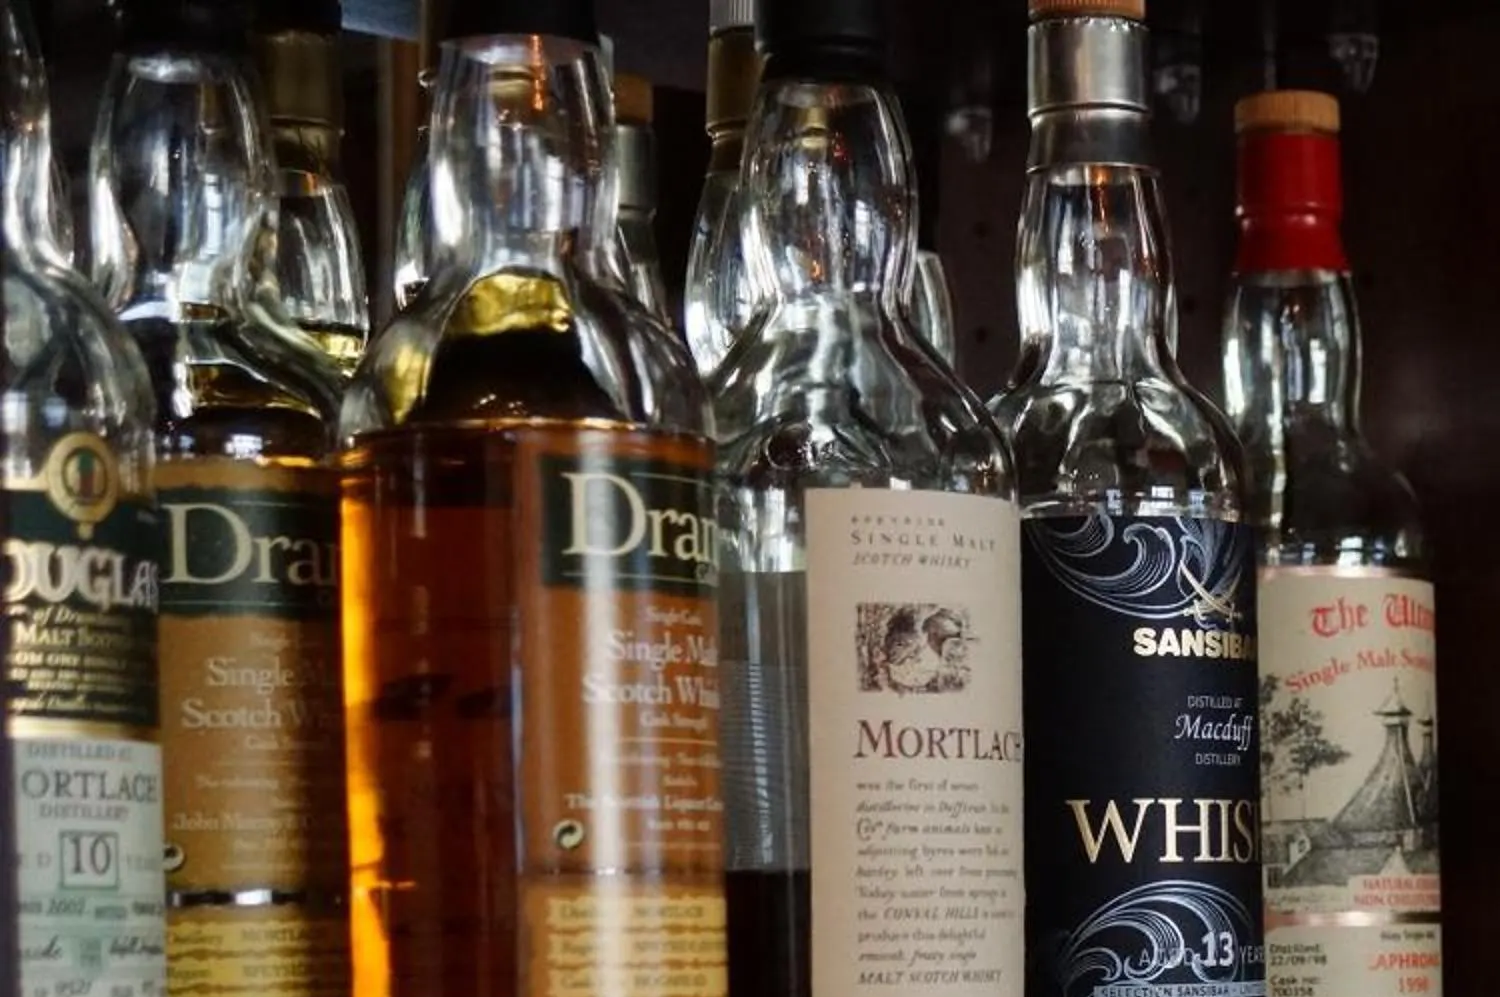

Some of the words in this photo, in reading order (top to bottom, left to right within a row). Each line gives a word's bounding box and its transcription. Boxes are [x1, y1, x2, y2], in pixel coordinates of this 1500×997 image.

[160, 502, 337, 586] Dra
[850, 530, 939, 546] SINGLE
[952, 533, 996, 551] MALT
[852, 553, 913, 566] SCOTCH
[918, 554, 973, 569] WHISKY
[1312, 596, 1369, 638] The
[206, 656, 294, 695] Single
[1285, 657, 1350, 694] Single
[181, 698, 282, 728] Scotch
[1174, 714, 1253, 751] Macduff
[70, 834, 111, 875] 10
[1202, 932, 1234, 966] 13
[909, 970, 960, 984] SCOTCH
